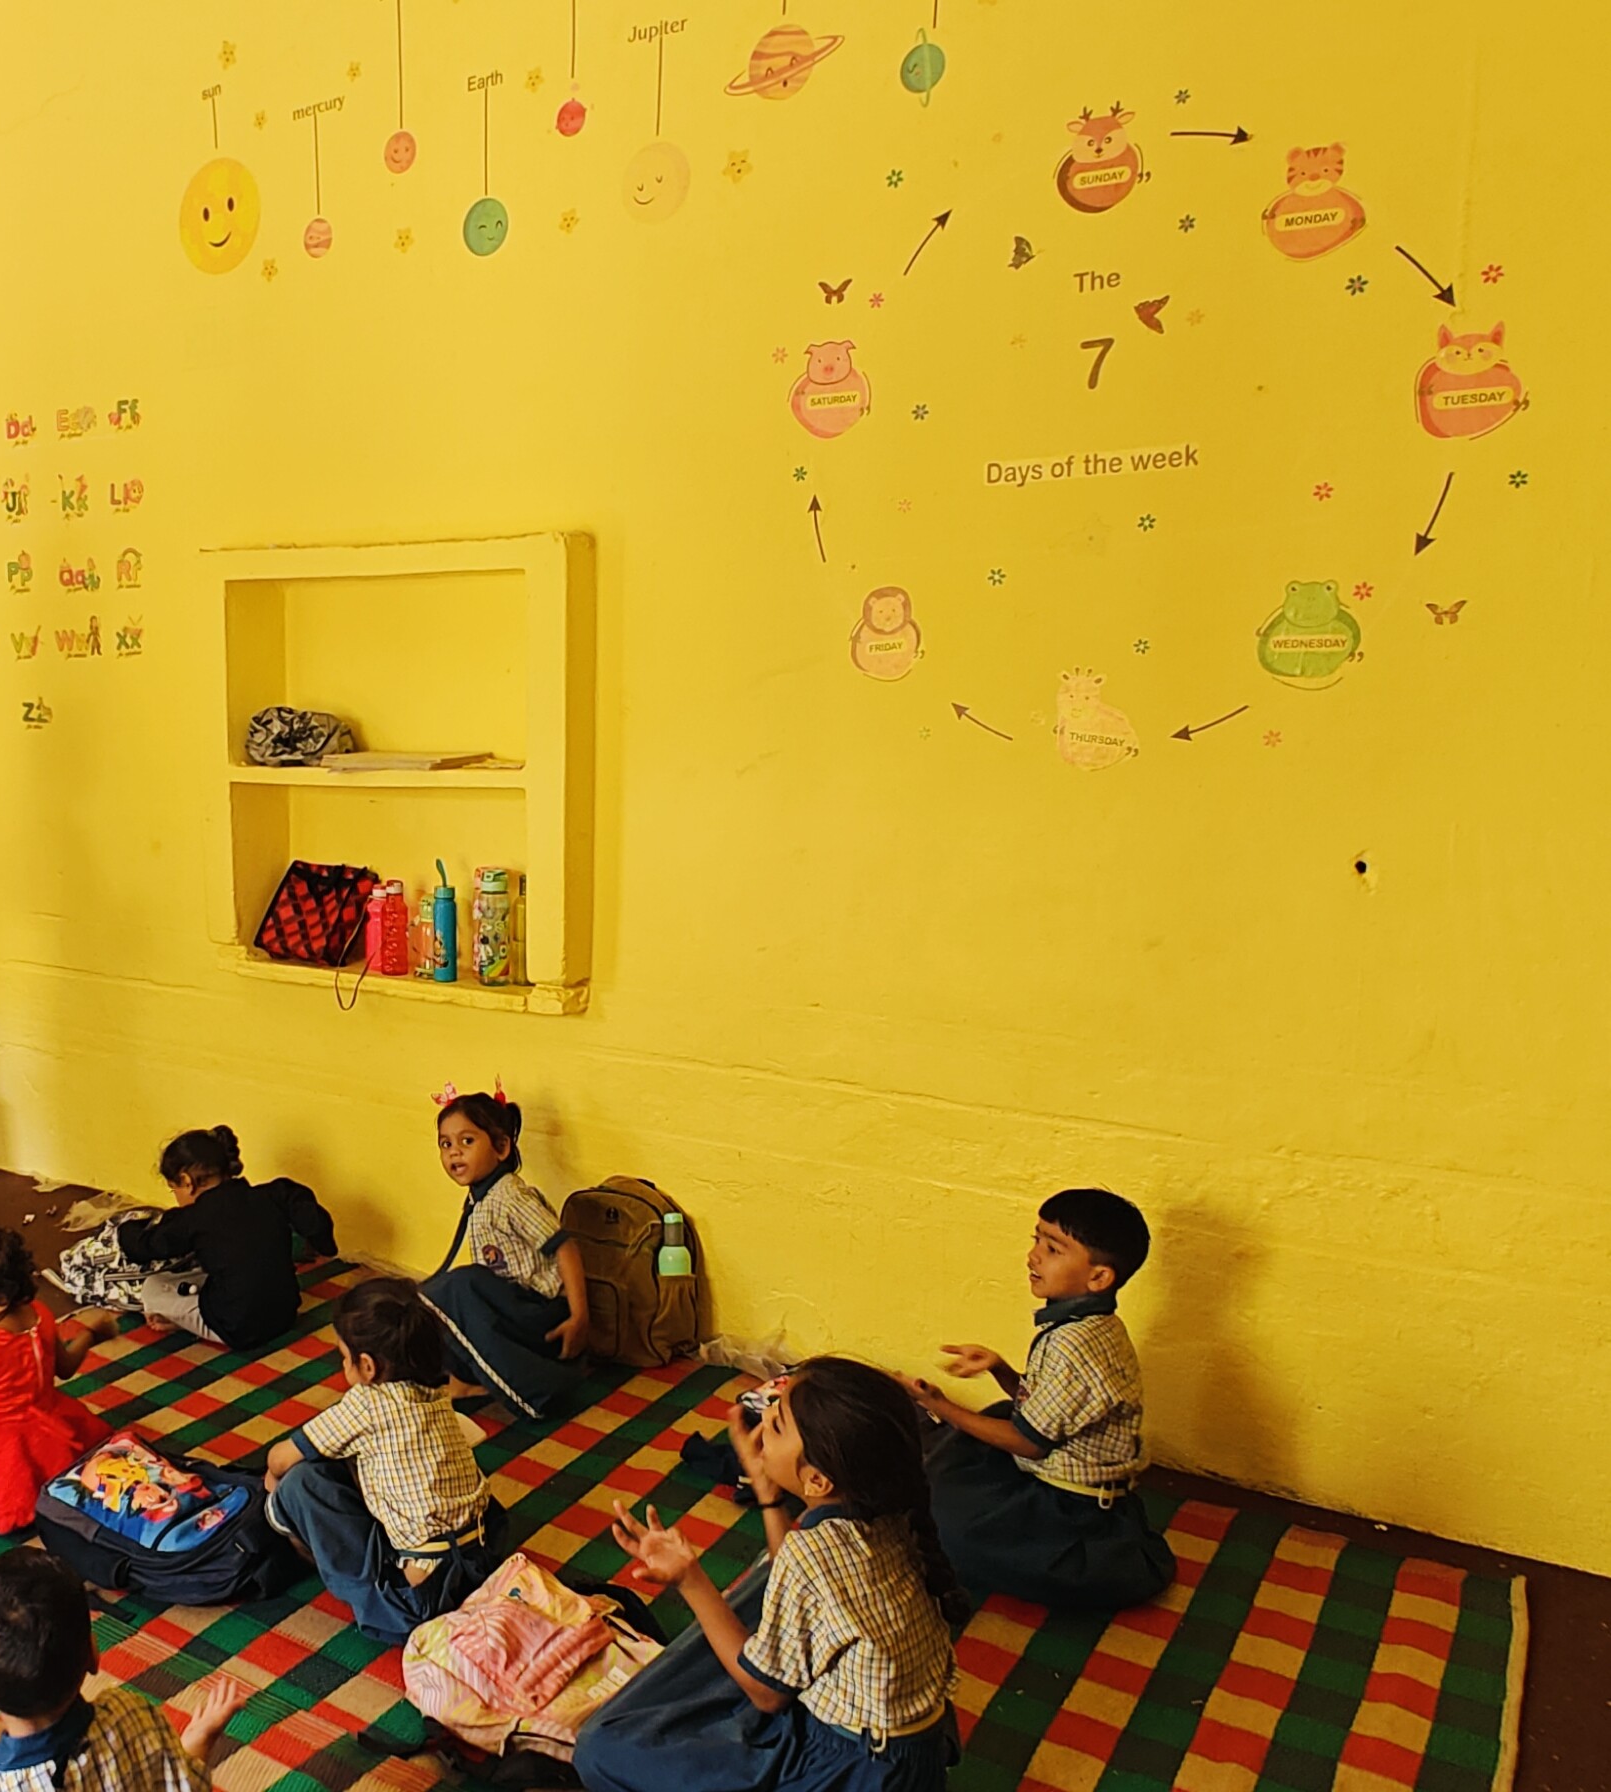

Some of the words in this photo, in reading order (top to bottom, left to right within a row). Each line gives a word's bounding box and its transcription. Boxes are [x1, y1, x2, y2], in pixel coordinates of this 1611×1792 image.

[627, 18, 688, 43] Jupiter
[467, 69, 503, 92] Earth
[201, 84, 222, 100] sun
[292, 95, 345, 121] mercury
[1079, 169, 1125, 186] SUNDAY
[1284, 211, 1338, 228] MONDAY
[1073, 270, 1121, 293] The
[1080, 337, 1115, 390] 7
[810, 393, 858, 407] SATURDAY
[1442, 390, 1507, 407] TUESDAY
[986, 461, 1043, 488] Days
[1051, 455, 1076, 478] of
[1083, 453, 1123, 476] the
[1130, 443, 1199, 472] week
[869, 641, 903, 653] FRIDAY
[1272, 638, 1348, 649] WEDNESDAY
[1069, 731, 1126, 747] THURSDAY
